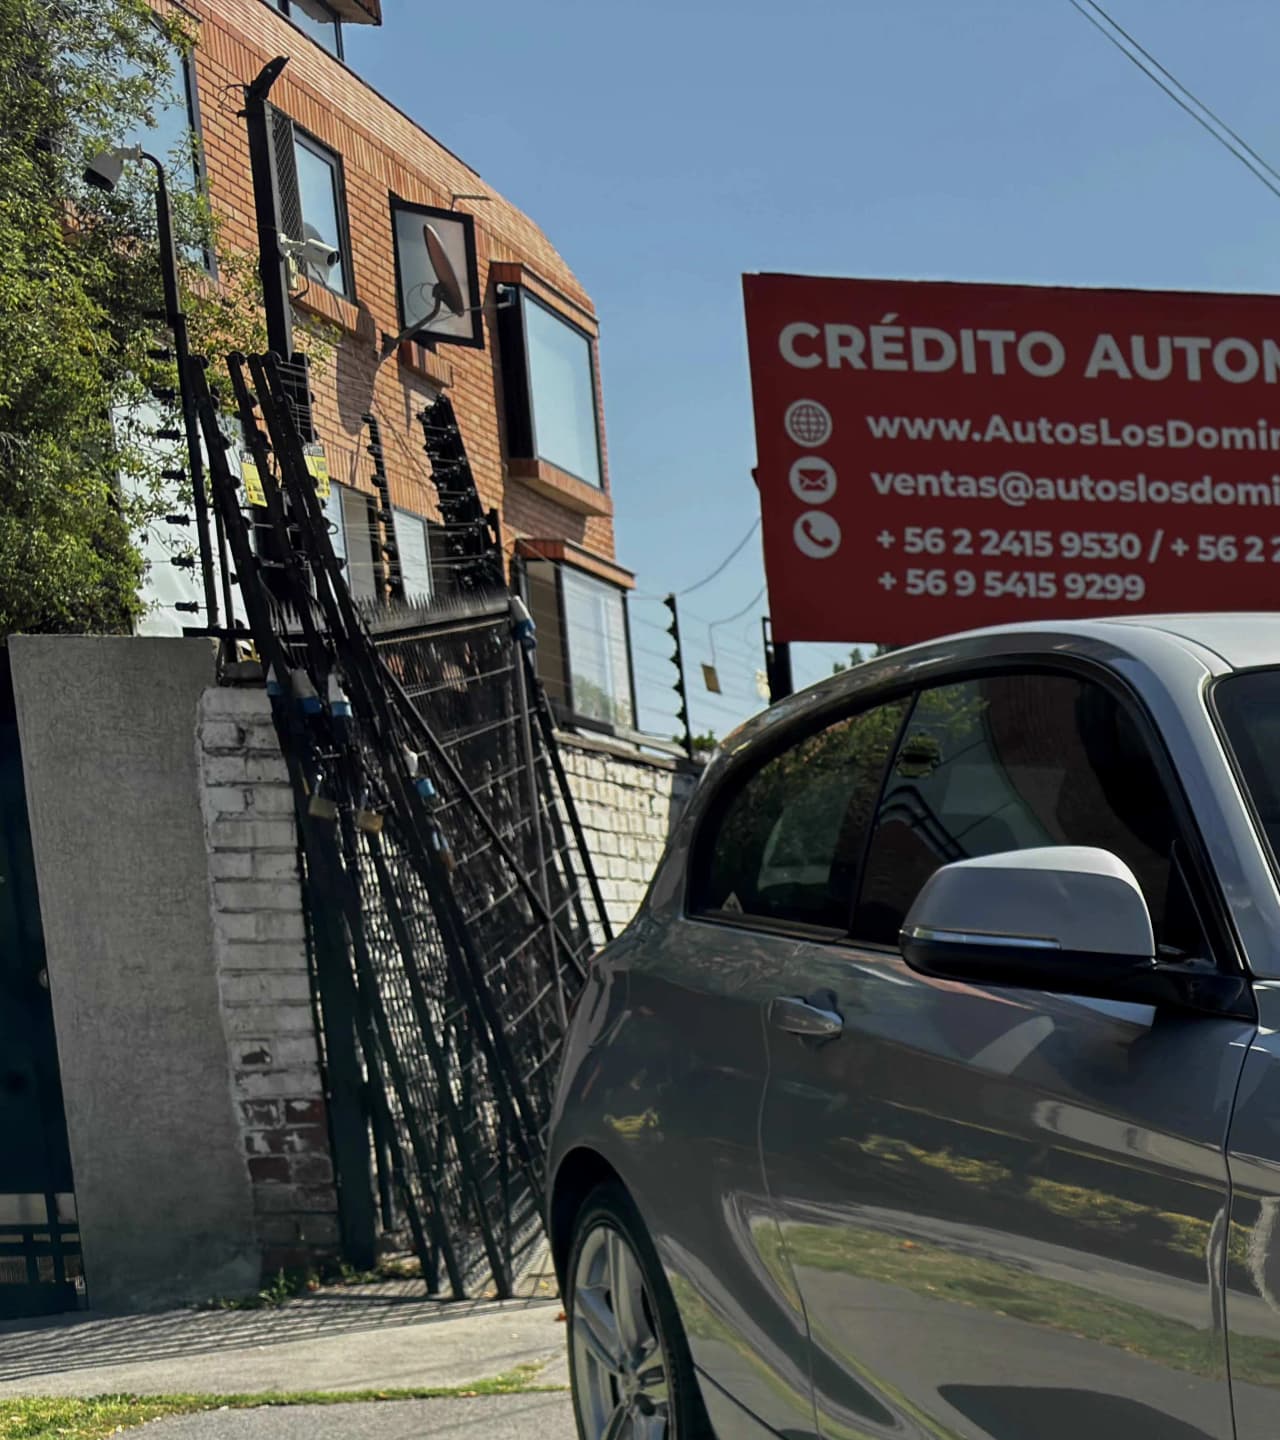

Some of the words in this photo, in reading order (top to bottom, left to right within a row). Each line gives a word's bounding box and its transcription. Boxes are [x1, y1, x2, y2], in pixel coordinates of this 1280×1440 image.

[779, 313, 1065, 377] CRÉDITO
[905, 527, 945, 554] 56
[954, 528, 974, 555] 2
[980, 529, 1053, 557] 2415
[1063, 531, 1141, 559] 9530
[1198, 535, 1237, 562] 56
[1247, 536, 1268, 562] 2
[906, 569, 947, 595] 56
[955, 570, 976, 597] 9
[984, 571, 1057, 598] 5415
[1064, 573, 1145, 600] 9299
